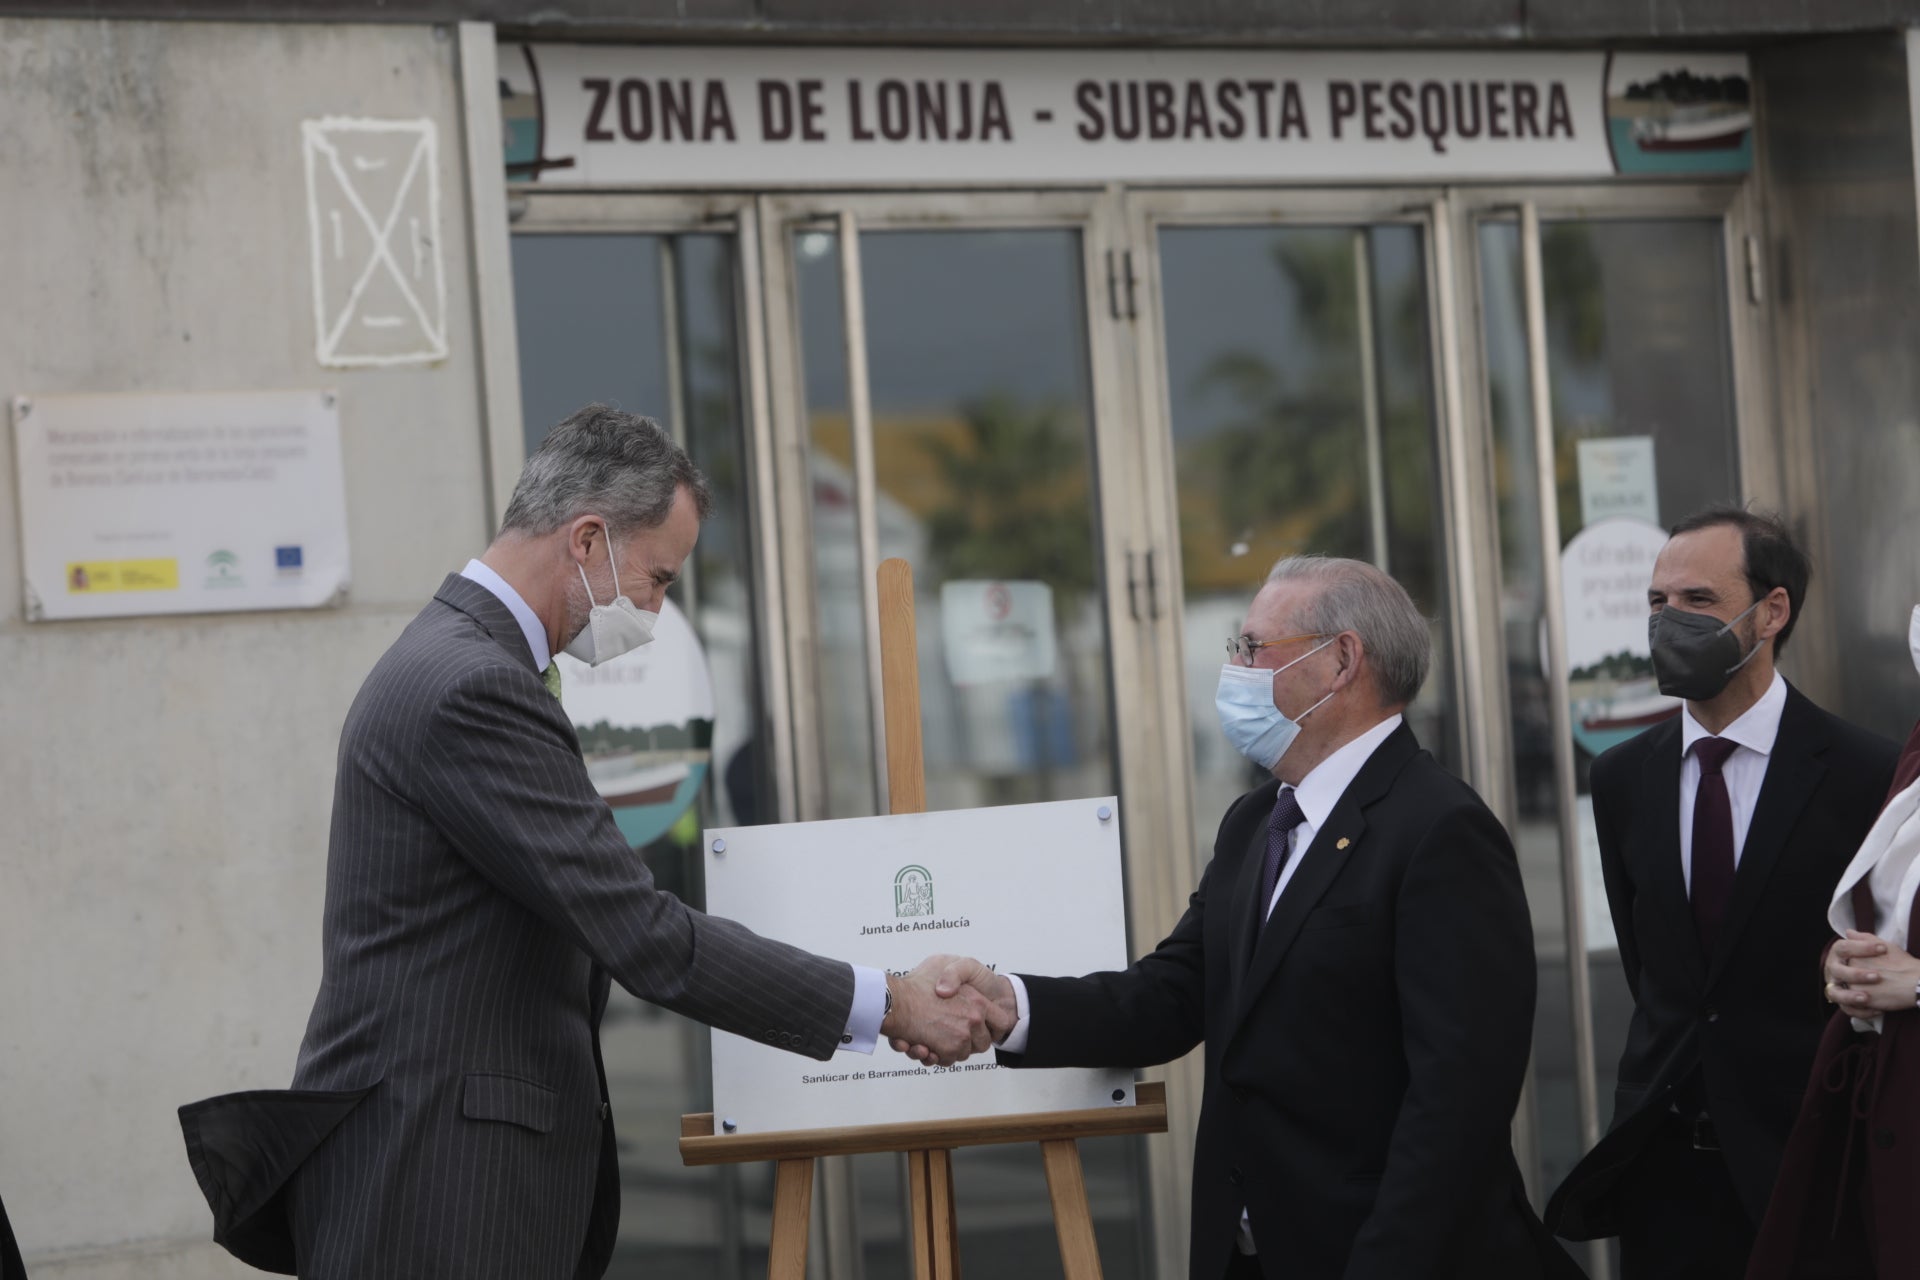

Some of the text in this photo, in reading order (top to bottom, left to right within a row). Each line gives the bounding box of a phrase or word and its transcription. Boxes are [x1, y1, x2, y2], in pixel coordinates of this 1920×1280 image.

[581, 78, 1577, 154] ZONA DE LONJA - SUBASTA PESQUERA
[860, 917, 970, 935] Junta de Andalucía
[801, 1073, 849, 1083] Sanlúcar
[852, 1071, 866, 1080] de
[868, 1066, 930, 1079] Barrameda,
[933, 1066, 947, 1074] 25
[949, 1064, 962, 1072] de
[965, 1063, 997, 1072] marzo
